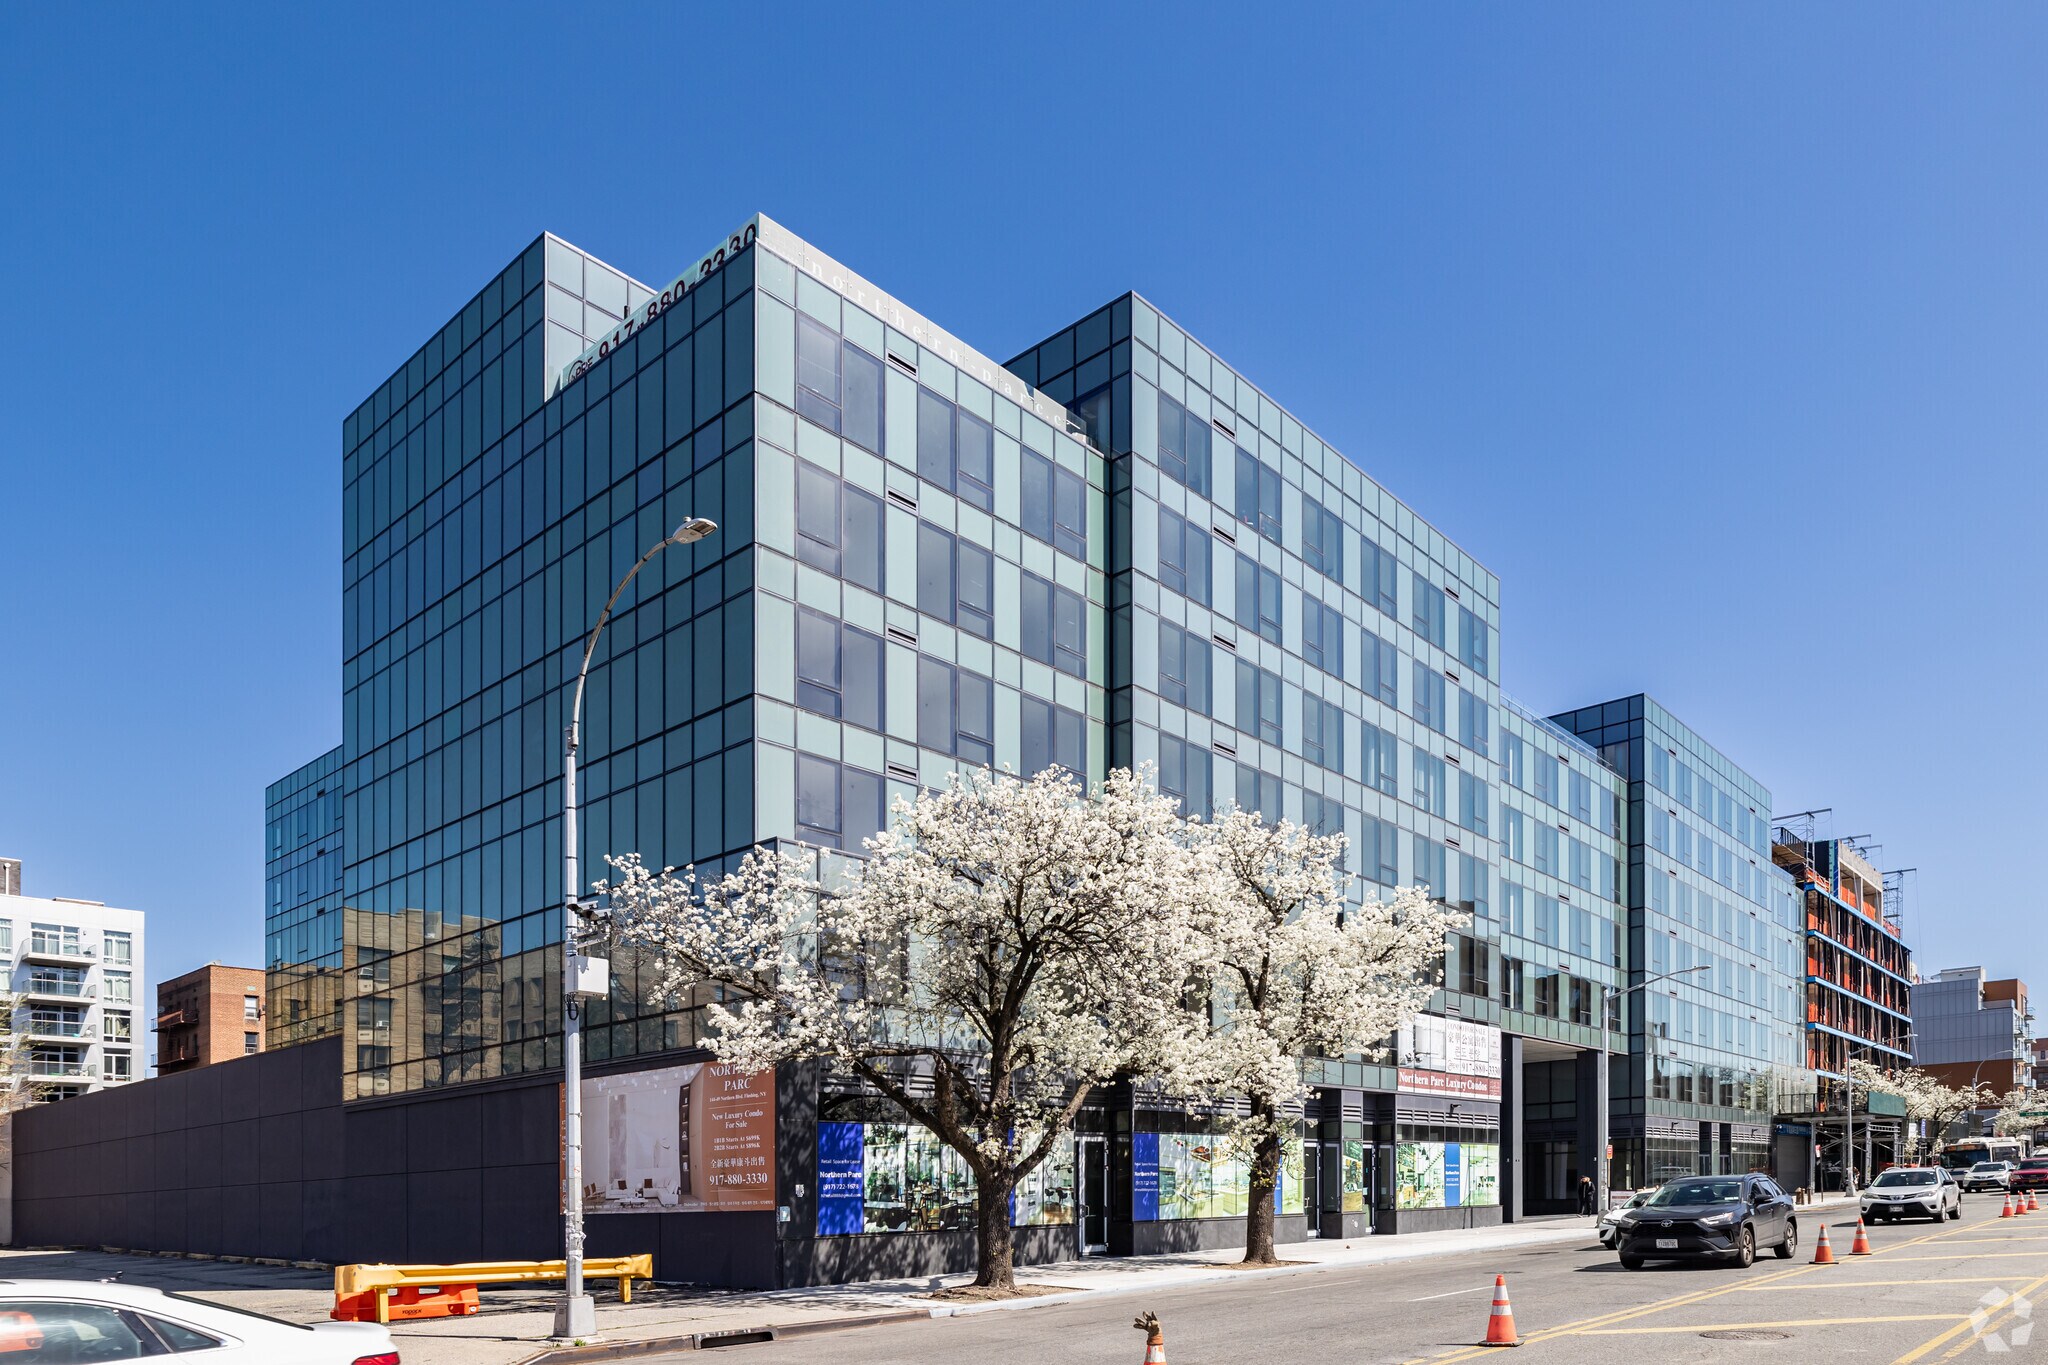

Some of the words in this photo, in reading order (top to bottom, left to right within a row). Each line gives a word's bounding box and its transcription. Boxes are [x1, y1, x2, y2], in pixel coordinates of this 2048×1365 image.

[724, 1077, 752, 1092] PARC
[1399, 1072, 1428, 1086] Northern
[1430, 1075, 1444, 1087] Parc
[1446, 1078, 1466, 1091] Luxury
[1467, 1079, 1487, 1091] Condos
[712, 1113, 724, 1121] New
[724, 1112, 743, 1120] Luxury
[744, 1109, 764, 1118] Condo
[725, 1121, 735, 1129] For
[735, 1120, 748, 1128] Sale
[709, 1172, 768, 1186] 917-880-3330
